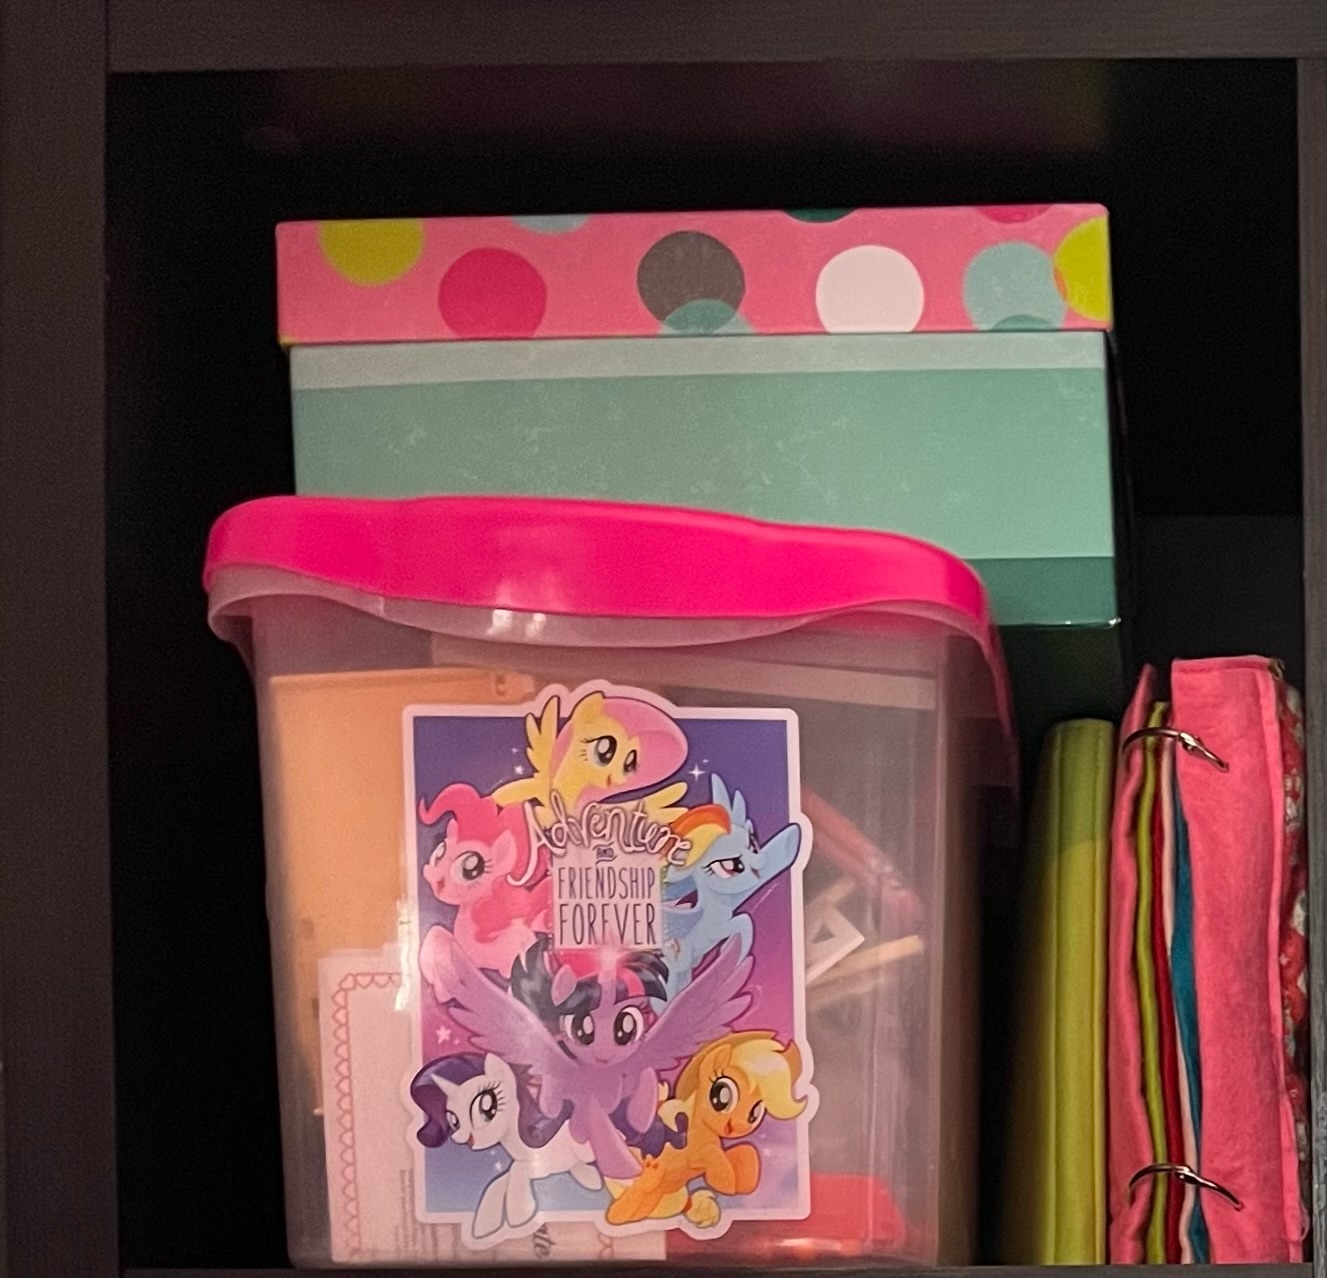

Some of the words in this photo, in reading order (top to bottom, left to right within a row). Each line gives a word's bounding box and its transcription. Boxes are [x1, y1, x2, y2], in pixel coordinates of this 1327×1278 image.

[506, 790, 693, 887] Adventure
[557, 866, 656, 900] FRIENDSHIP
[558, 903, 658, 946] FOREVER
